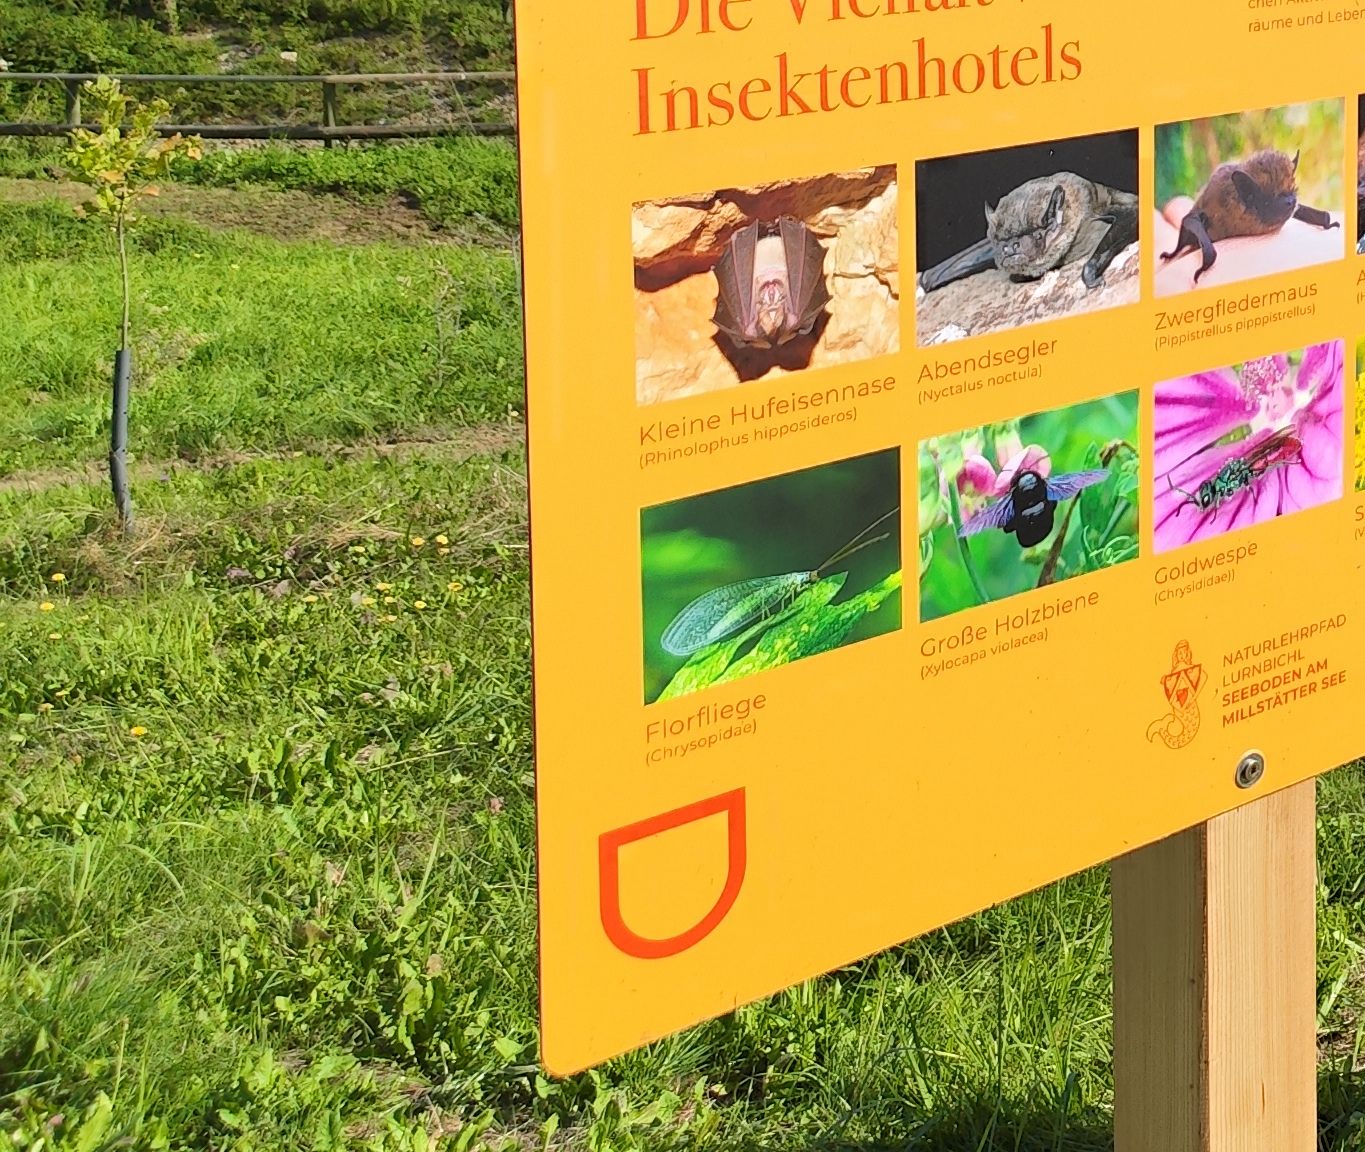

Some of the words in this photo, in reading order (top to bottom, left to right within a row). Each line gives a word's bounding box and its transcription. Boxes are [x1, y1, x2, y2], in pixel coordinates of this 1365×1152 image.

[1248, 17, 1292, 32] räume
[1297, 12, 1323, 26] und
[631, 23, 1083, 136] Insektenhotels
[1154, 283, 1318, 330] Zwergfledermaus
[1155, 323, 1232, 351] (Pippistrellus
[1236, 304, 1316, 332] pipppistrellus)
[917, 339, 1058, 384] Abendsegler
[917, 378, 984, 405] (Nyctalus
[986, 364, 1043, 389] noctula)
[639, 412, 722, 447] Kleine
[730, 375, 897, 426] Hufeisennase
[639, 431, 750, 469] (Rhinolophus
[753, 407, 858, 443] hipposideros)
[1154, 542, 1258, 584] Goldwespe
[919, 626, 988, 658] Große
[994, 590, 1100, 635] Holzbiene
[1223, 613, 1347, 668] NATURLEHRPFAD
[919, 648, 987, 680] (Xylocapa
[990, 628, 1049, 657] violacea)
[1222, 651, 1305, 688] LURNBICHL
[1222, 669, 1302, 708] SEEBODEN
[1306, 658, 1328, 677] AM
[1222, 682, 1318, 728] MILLSTÄTTER
[1320, 670, 1347, 694] SEE
[644, 692, 767, 744] Florfliege
[645, 719, 757, 767] (Chrysopidae)
